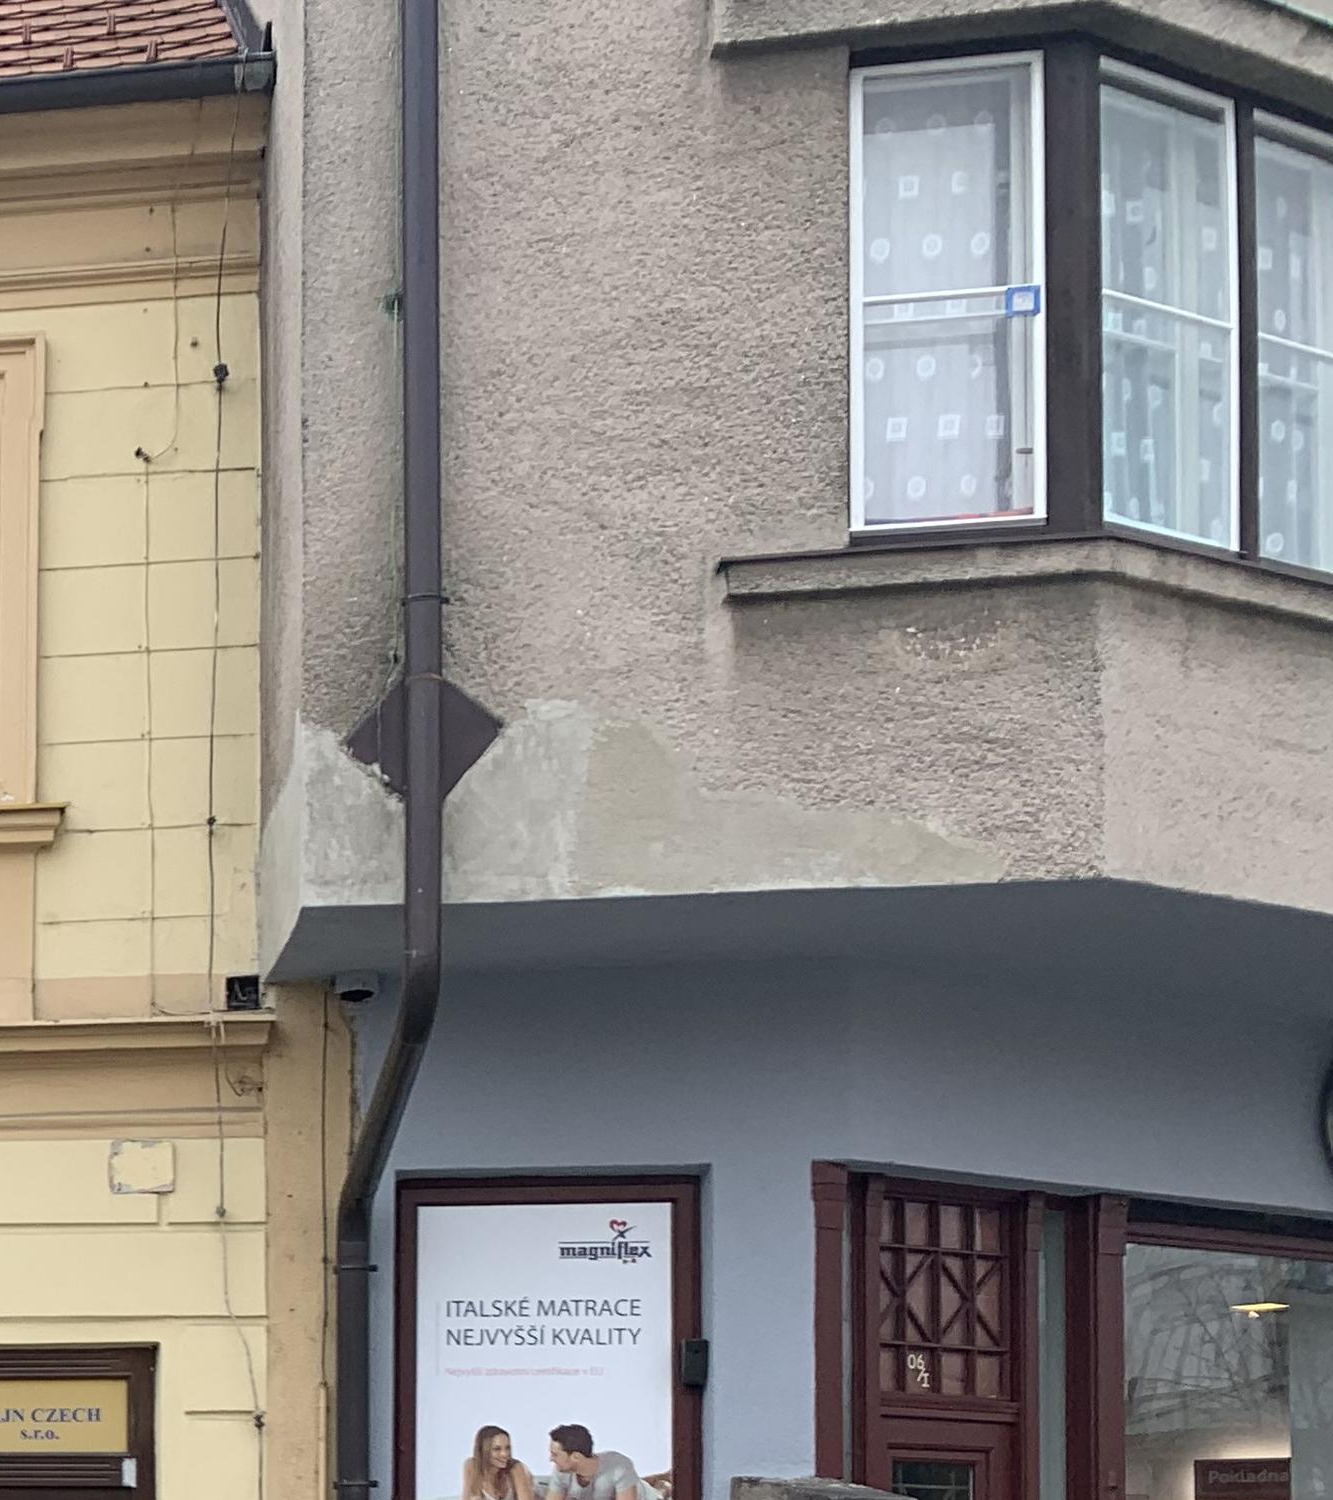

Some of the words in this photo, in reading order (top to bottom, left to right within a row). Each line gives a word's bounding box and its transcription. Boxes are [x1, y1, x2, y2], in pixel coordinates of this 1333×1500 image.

[558, 1240, 652, 1260] magniflex
[445, 1297, 531, 1317] ITALSKÉ
[536, 1299, 642, 1317] MATRACE
[445, 1325, 546, 1346] NEJVYŠŠÍ
[551, 1328, 642, 1346] KVALITY
[30, 1407, 101, 1423] CZECH
[19, 1428, 60, 1441] s.r.o.
[1208, 1469, 1290, 1485] Pokladna
